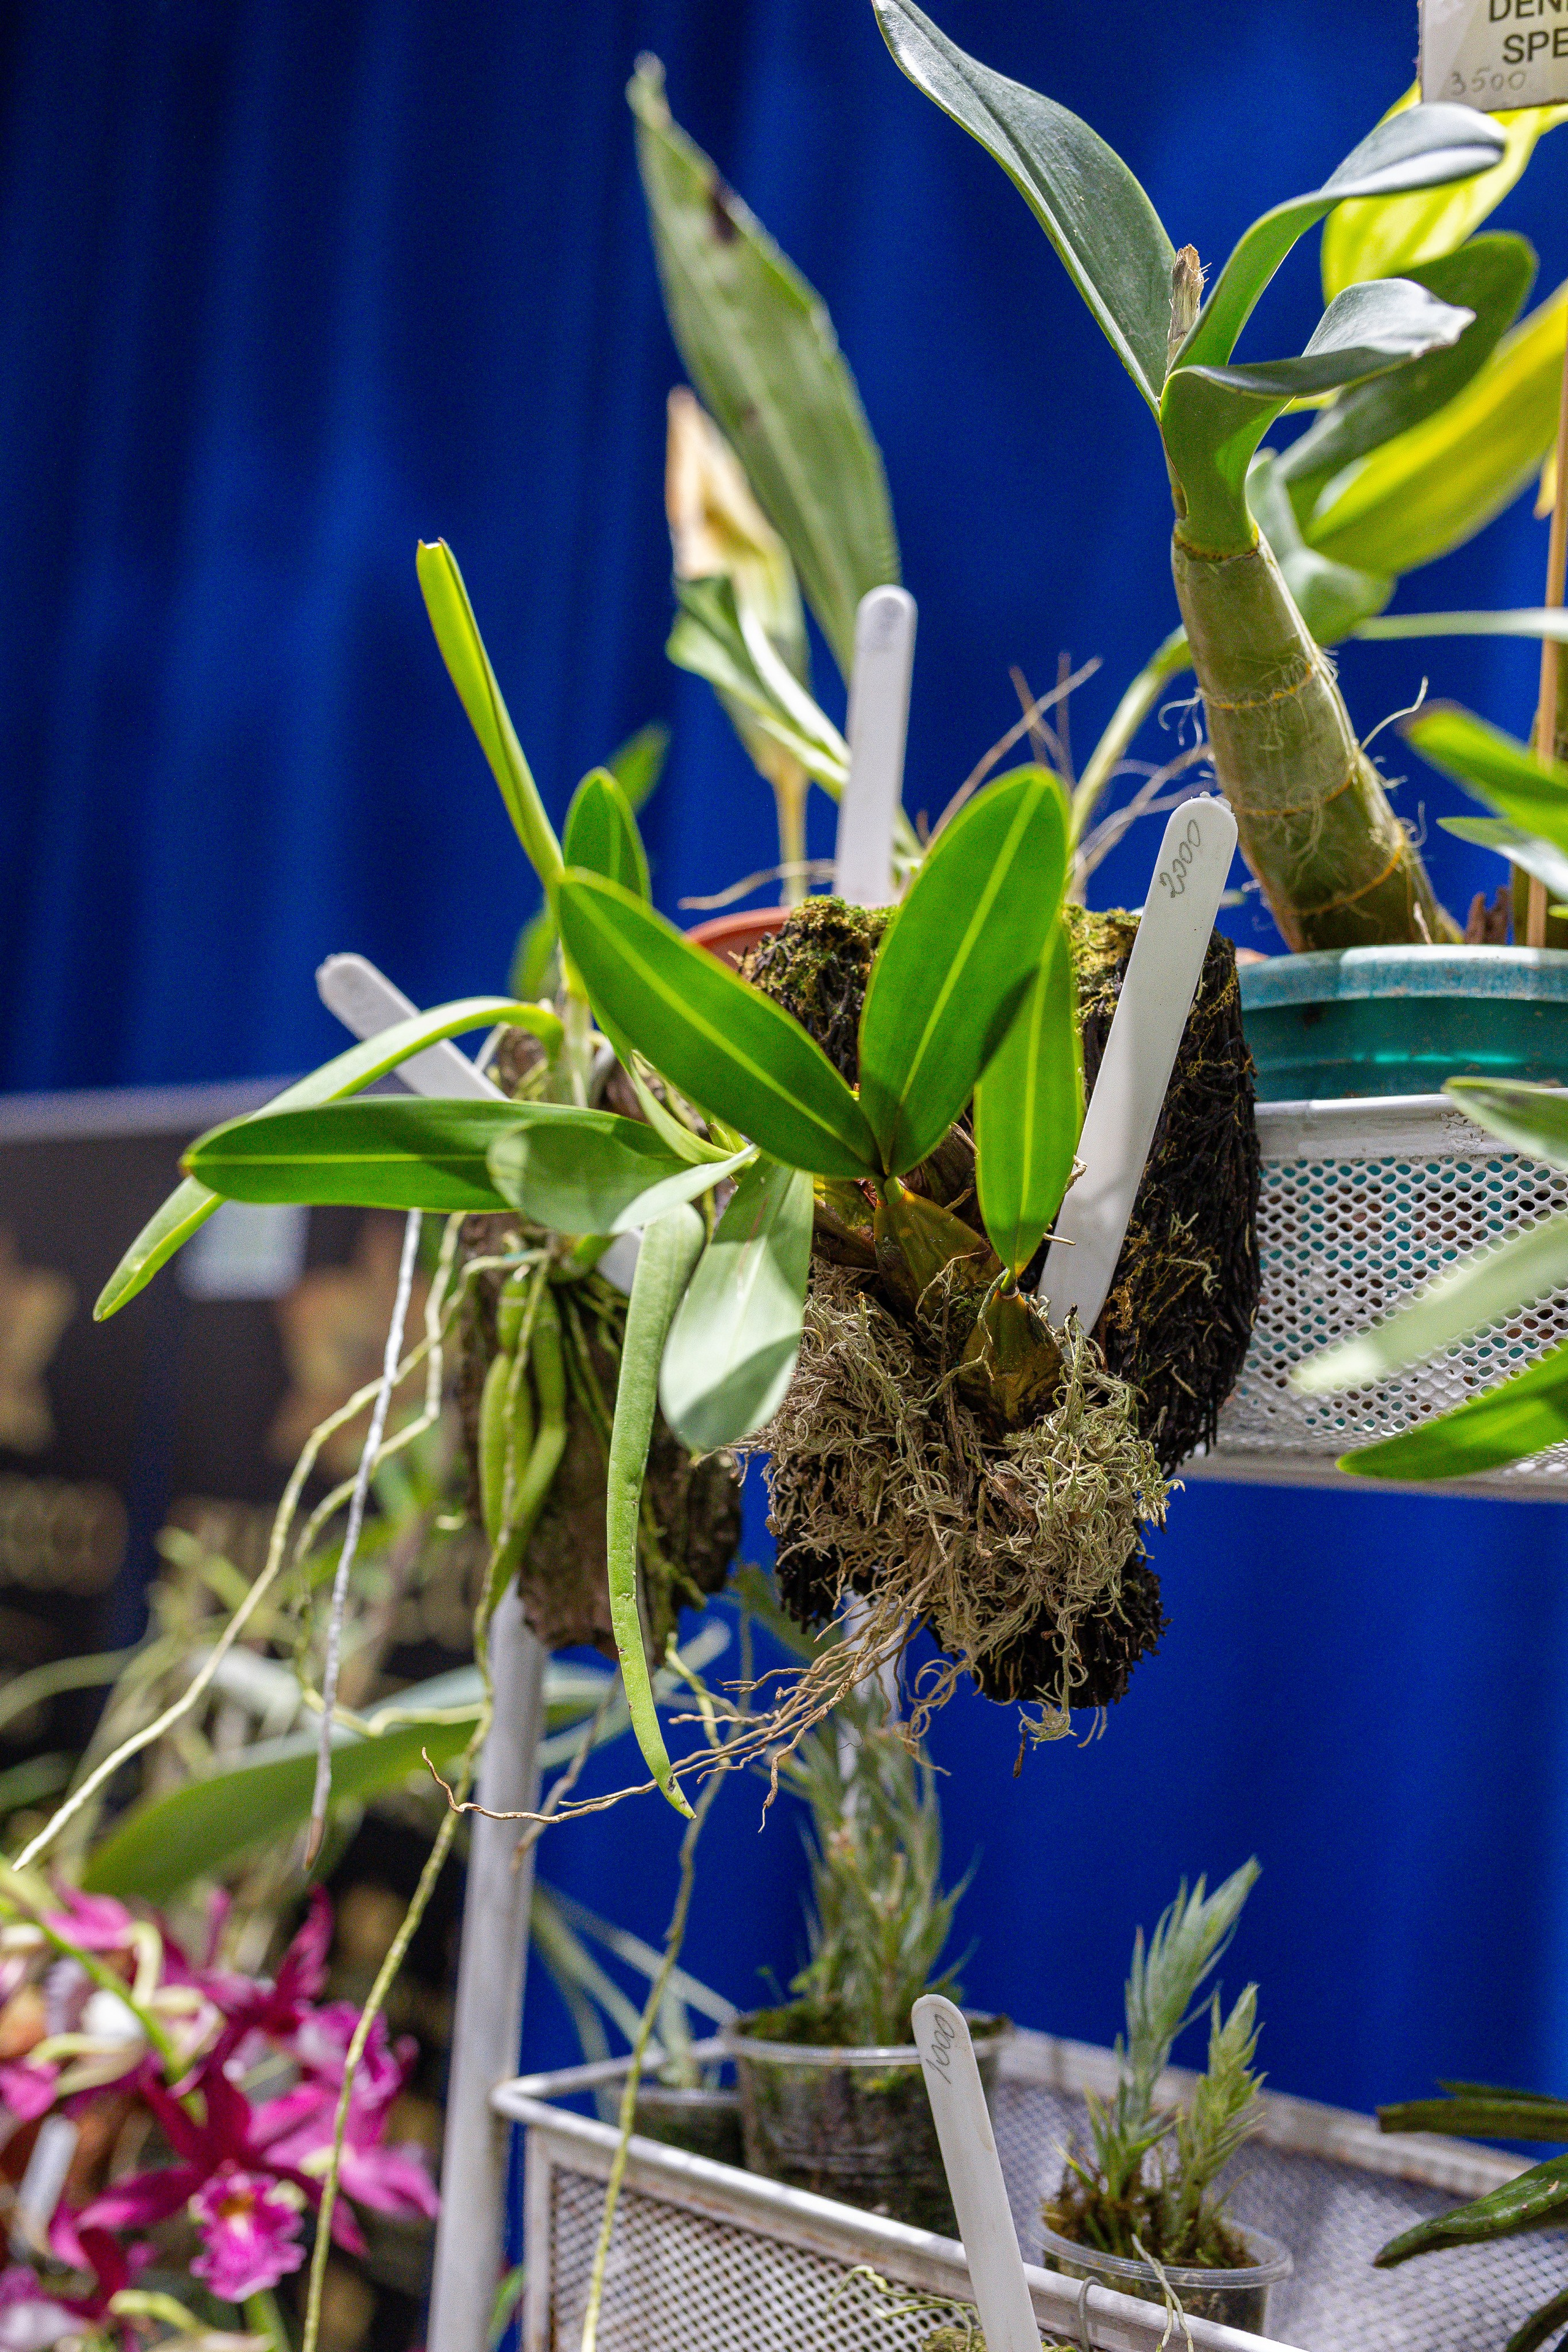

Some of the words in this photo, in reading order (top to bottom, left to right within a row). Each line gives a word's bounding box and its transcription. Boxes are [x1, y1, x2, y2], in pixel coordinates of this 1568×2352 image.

[1502, 27, 1568, 64] SPE
[1450, 66, 1527, 96] 3500
[1159, 818, 1201, 899] 2000
[925, 2013, 955, 2084] 1000
